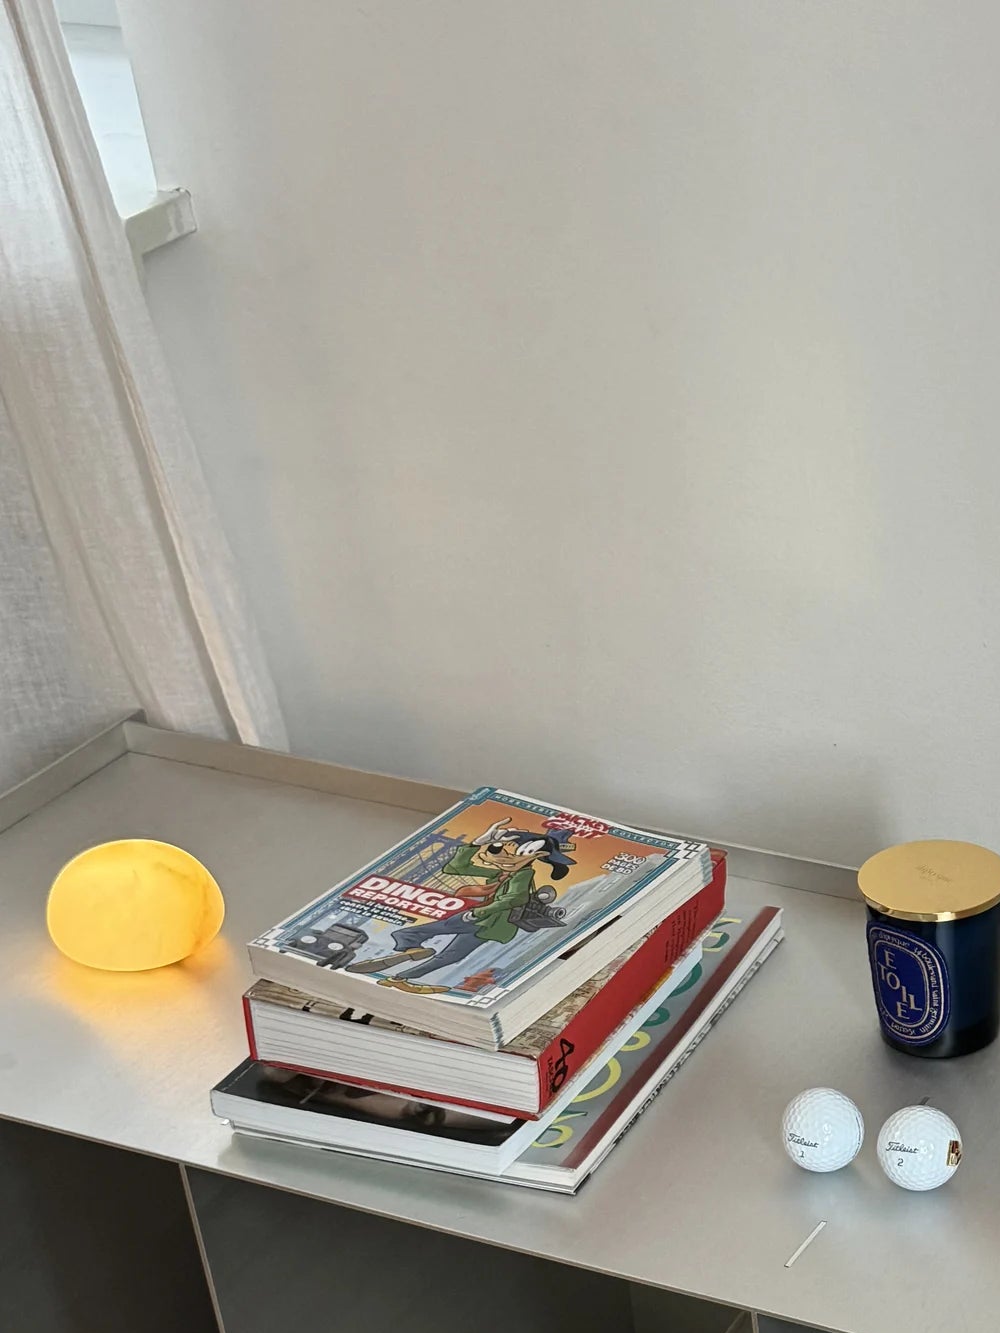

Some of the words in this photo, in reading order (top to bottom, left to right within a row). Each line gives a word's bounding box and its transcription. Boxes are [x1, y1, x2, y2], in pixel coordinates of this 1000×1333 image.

[608, 859, 639, 870] PAGES
[615, 852, 646, 865] 300
[601, 863, 617, 871] DE
[359, 877, 466, 911] DINGO
[349, 888, 447, 918] REPORTER
[787, 1133, 819, 1149] Titleist
[885, 1141, 919, 1154] Titleist
[799, 1150, 805, 1158] 1
[897, 1158, 904, 1167] 2
